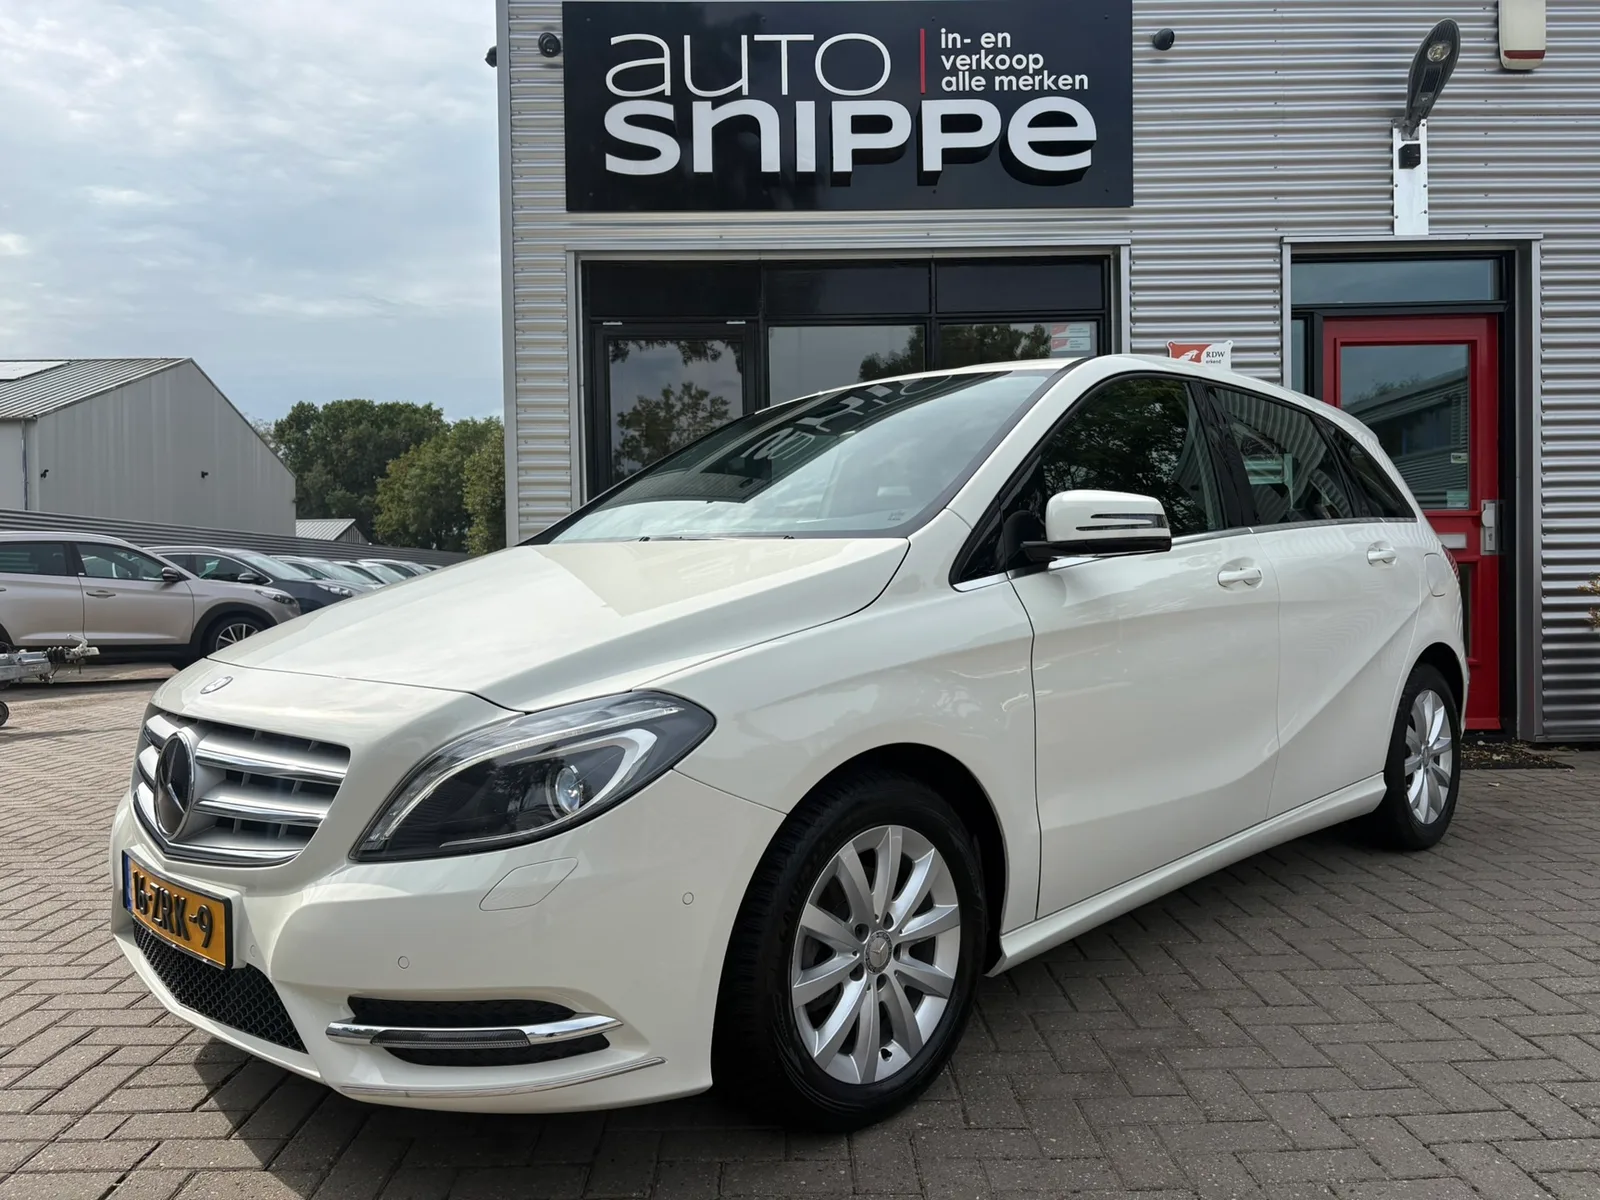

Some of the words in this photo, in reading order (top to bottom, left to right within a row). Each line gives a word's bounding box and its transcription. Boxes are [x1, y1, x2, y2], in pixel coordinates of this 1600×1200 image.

[940, 28, 972, 49] in-
[980, 32, 1011, 49] en
[940, 50, 1044, 74] verkoop
[941, 71, 987, 92] alle
[994, 70, 1089, 91] merken
[1205, 351, 1226, 359] RDW
[132, 869, 214, 949] 16-ZRK-9
